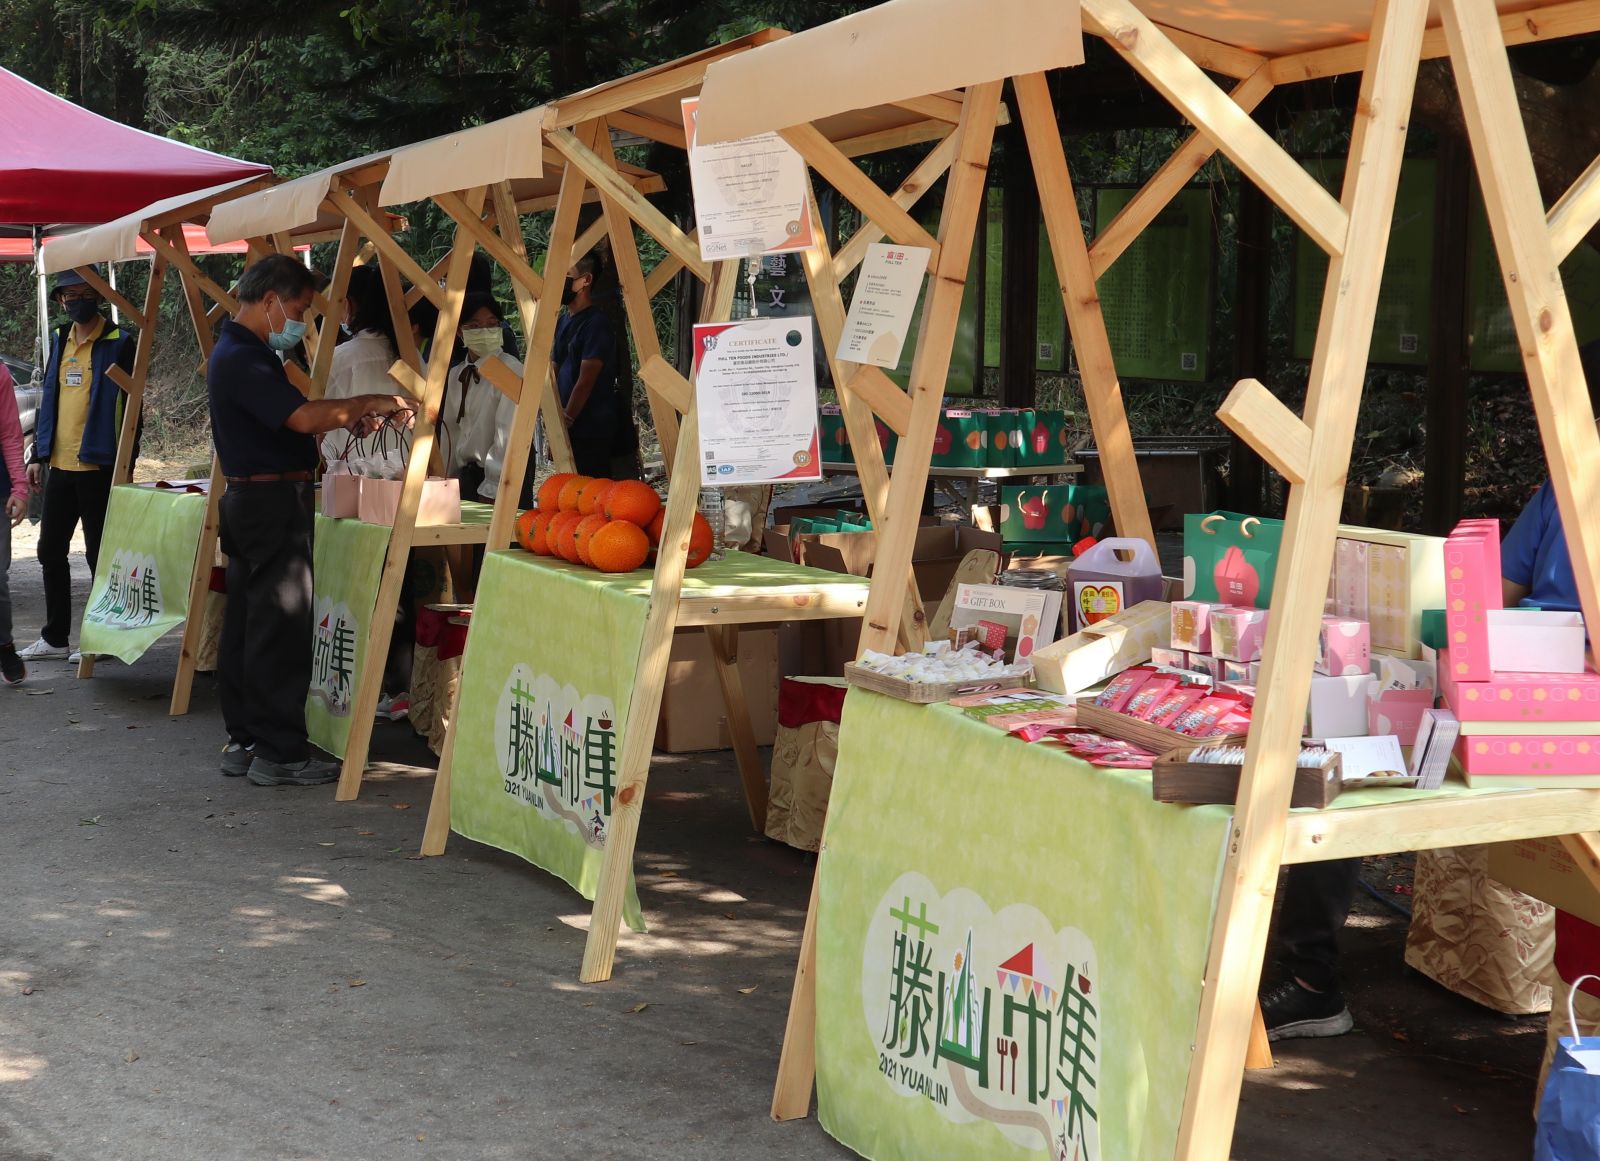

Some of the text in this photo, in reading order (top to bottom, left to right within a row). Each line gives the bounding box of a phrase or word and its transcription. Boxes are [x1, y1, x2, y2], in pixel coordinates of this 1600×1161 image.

[728, 338, 777, 347] CERTIFICATE
[970, 597, 1006, 609] GIFT BOX
[521, 786, 544, 811] YUANLIN
[881, 896, 1098, 1161] 藤山市集
[900, 1063, 948, 1107] YUANLIN
